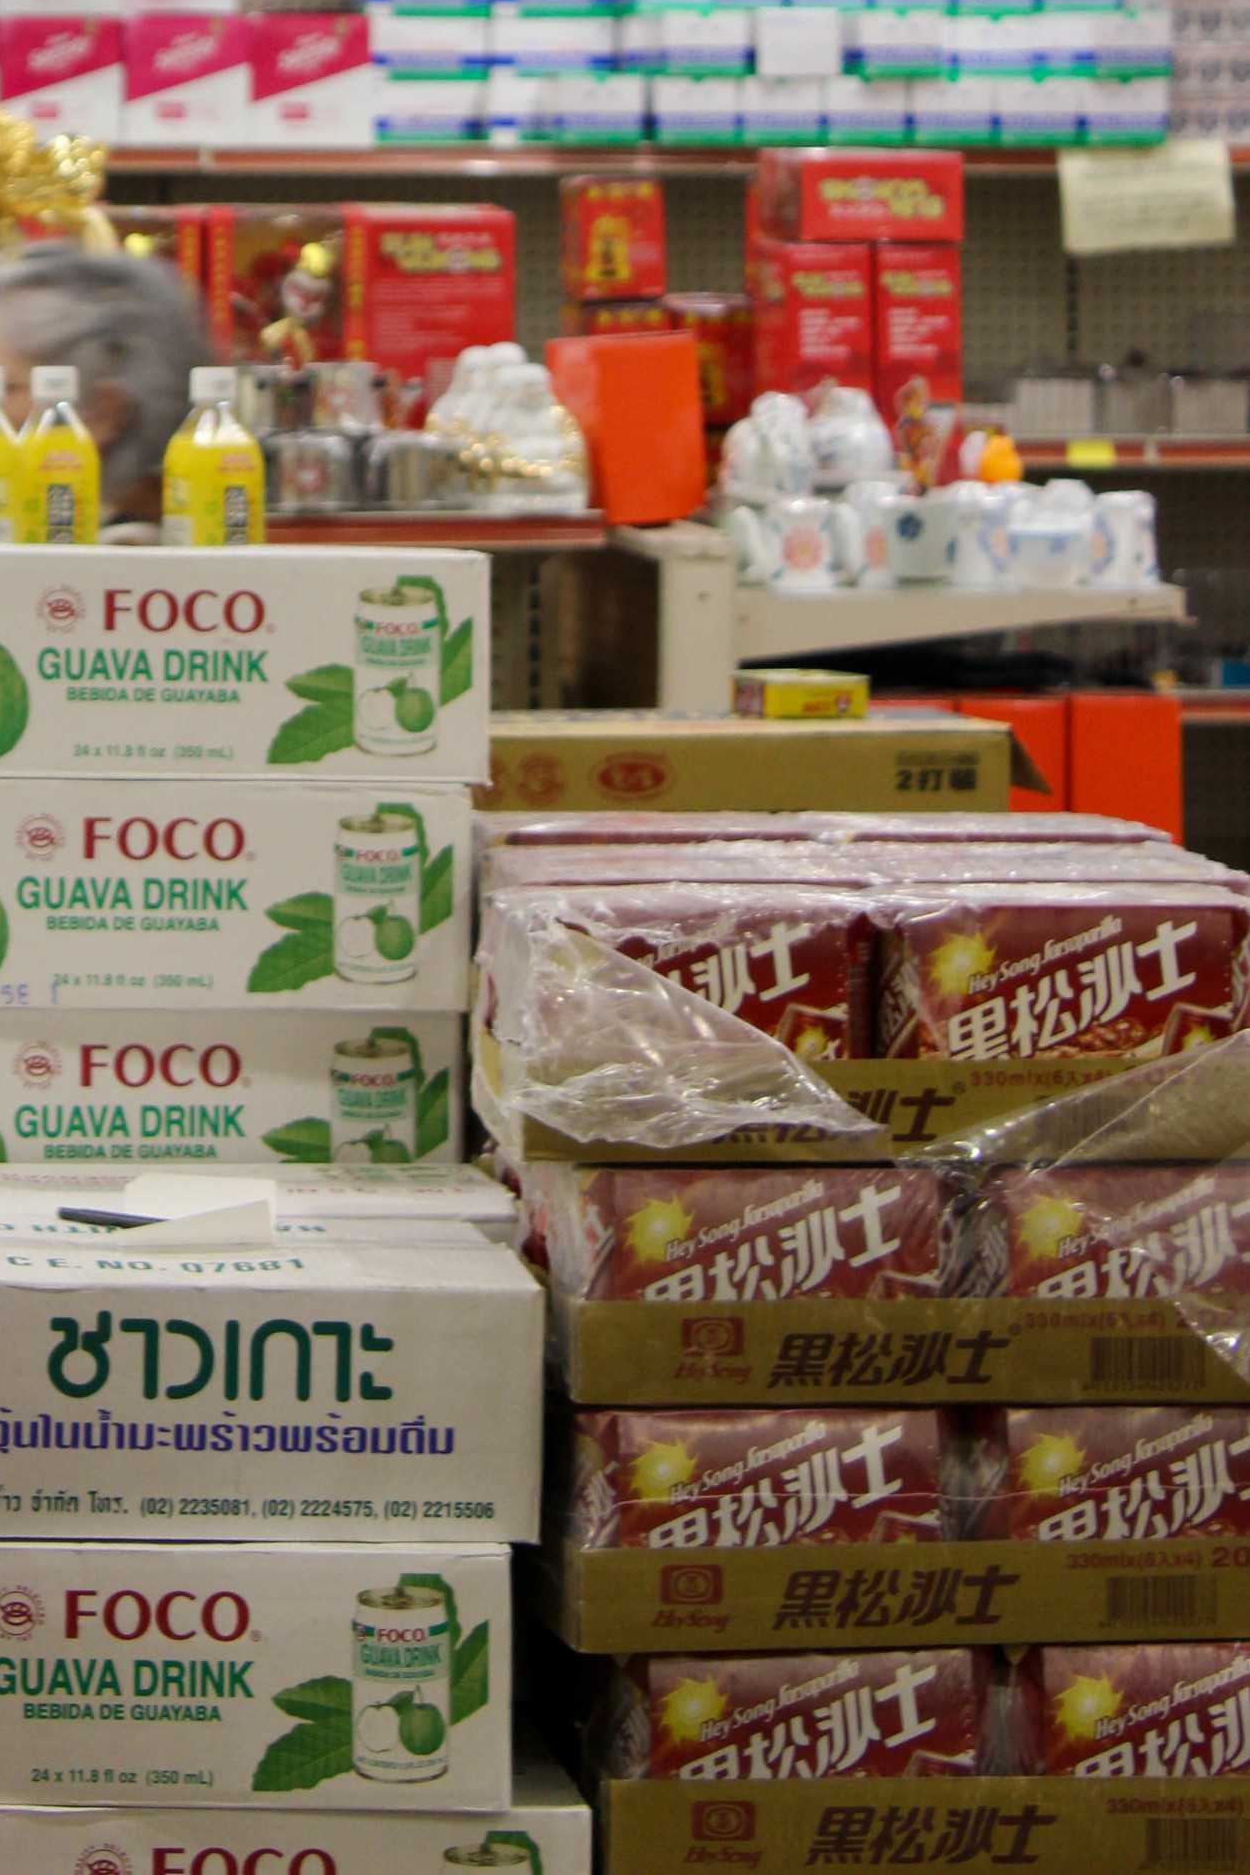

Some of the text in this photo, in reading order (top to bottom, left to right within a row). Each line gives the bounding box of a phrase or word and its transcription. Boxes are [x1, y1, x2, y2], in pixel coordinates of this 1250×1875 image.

[103, 588, 266, 633] FOCO
[37, 646, 269, 683] GUAVA DRINK
[67, 686, 240, 703] BEBIDA DE GUAYABA
[82, 815, 246, 860] FOCO
[17, 875, 249, 911] GUAVA DRINK
[46, 915, 220, 932] BEBIDA DE GUAYABA
[947, 920, 1199, 1060] 黑松沙士
[79, 1043, 243, 1088] FOCO
[14, 1103, 246, 1139] GUAVA DRINK
[43, 1143, 218, 1160] BEBIDA DE GUAYABA
[96, 1259, 168, 1272] NO.
[180, 1257, 306, 1275] 07681
[46, 1308, 397, 1404] ชาวเกาะ
[767, 1329, 1010, 1390] 黑松沙士
[139, 1497, 174, 1518] (02)
[178, 1499, 256, 1518] 2235081,
[261, 1499, 296, 1519] (02)
[300, 1500, 378, 1519] 2224575,
[383, 1500, 417, 1520] (02)
[422, 1501, 495, 1520] 2215506
[65, 1588, 251, 1642] FOCO
[772, 1563, 1020, 1630] 黑松沙士
[376, 1627, 426, 1643] FOCO
[133, 1658, 255, 1698] DRINK
[23, 1703, 222, 1722] BEBIDA DE GUAYABA
[30, 1768, 214, 1787] 24 x 11.8 fl oz (350 mL)
[805, 1805, 1058, 1868] 黑松沙士
